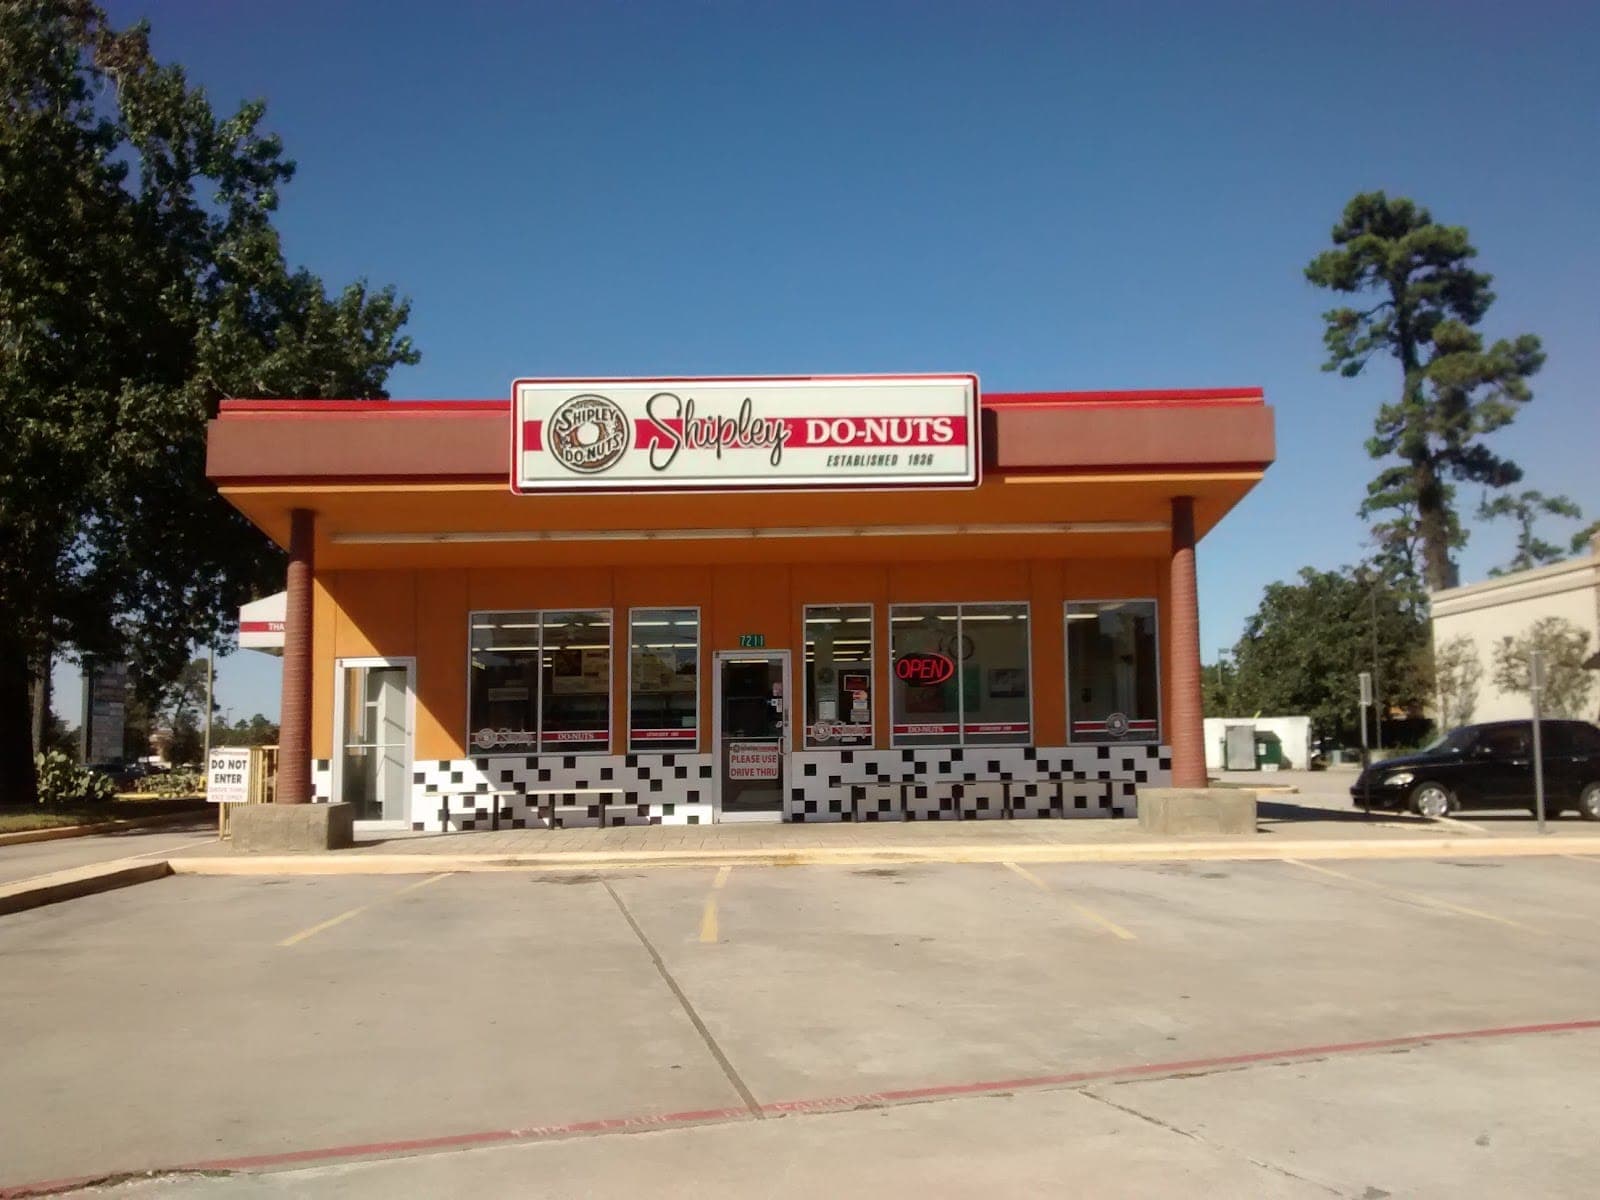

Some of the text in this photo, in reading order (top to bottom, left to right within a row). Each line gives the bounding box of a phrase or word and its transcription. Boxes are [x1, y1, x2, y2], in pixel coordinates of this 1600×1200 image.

[558, 408, 616, 431] SHIPLEY
[646, 392, 954, 471] Shipley DO-NUTS
[827, 454, 898, 467] ESTABLISHED
[269, 622, 286, 632] THA
[739, 635, 763, 647] 7211
[896, 658, 944, 679] OPEN
[731, 754, 777, 763] PLEASE USE
[211, 759, 248, 770] DO NOT
[730, 767, 777, 777] DRIVE THRU
[214, 773, 242, 784] ENTER
